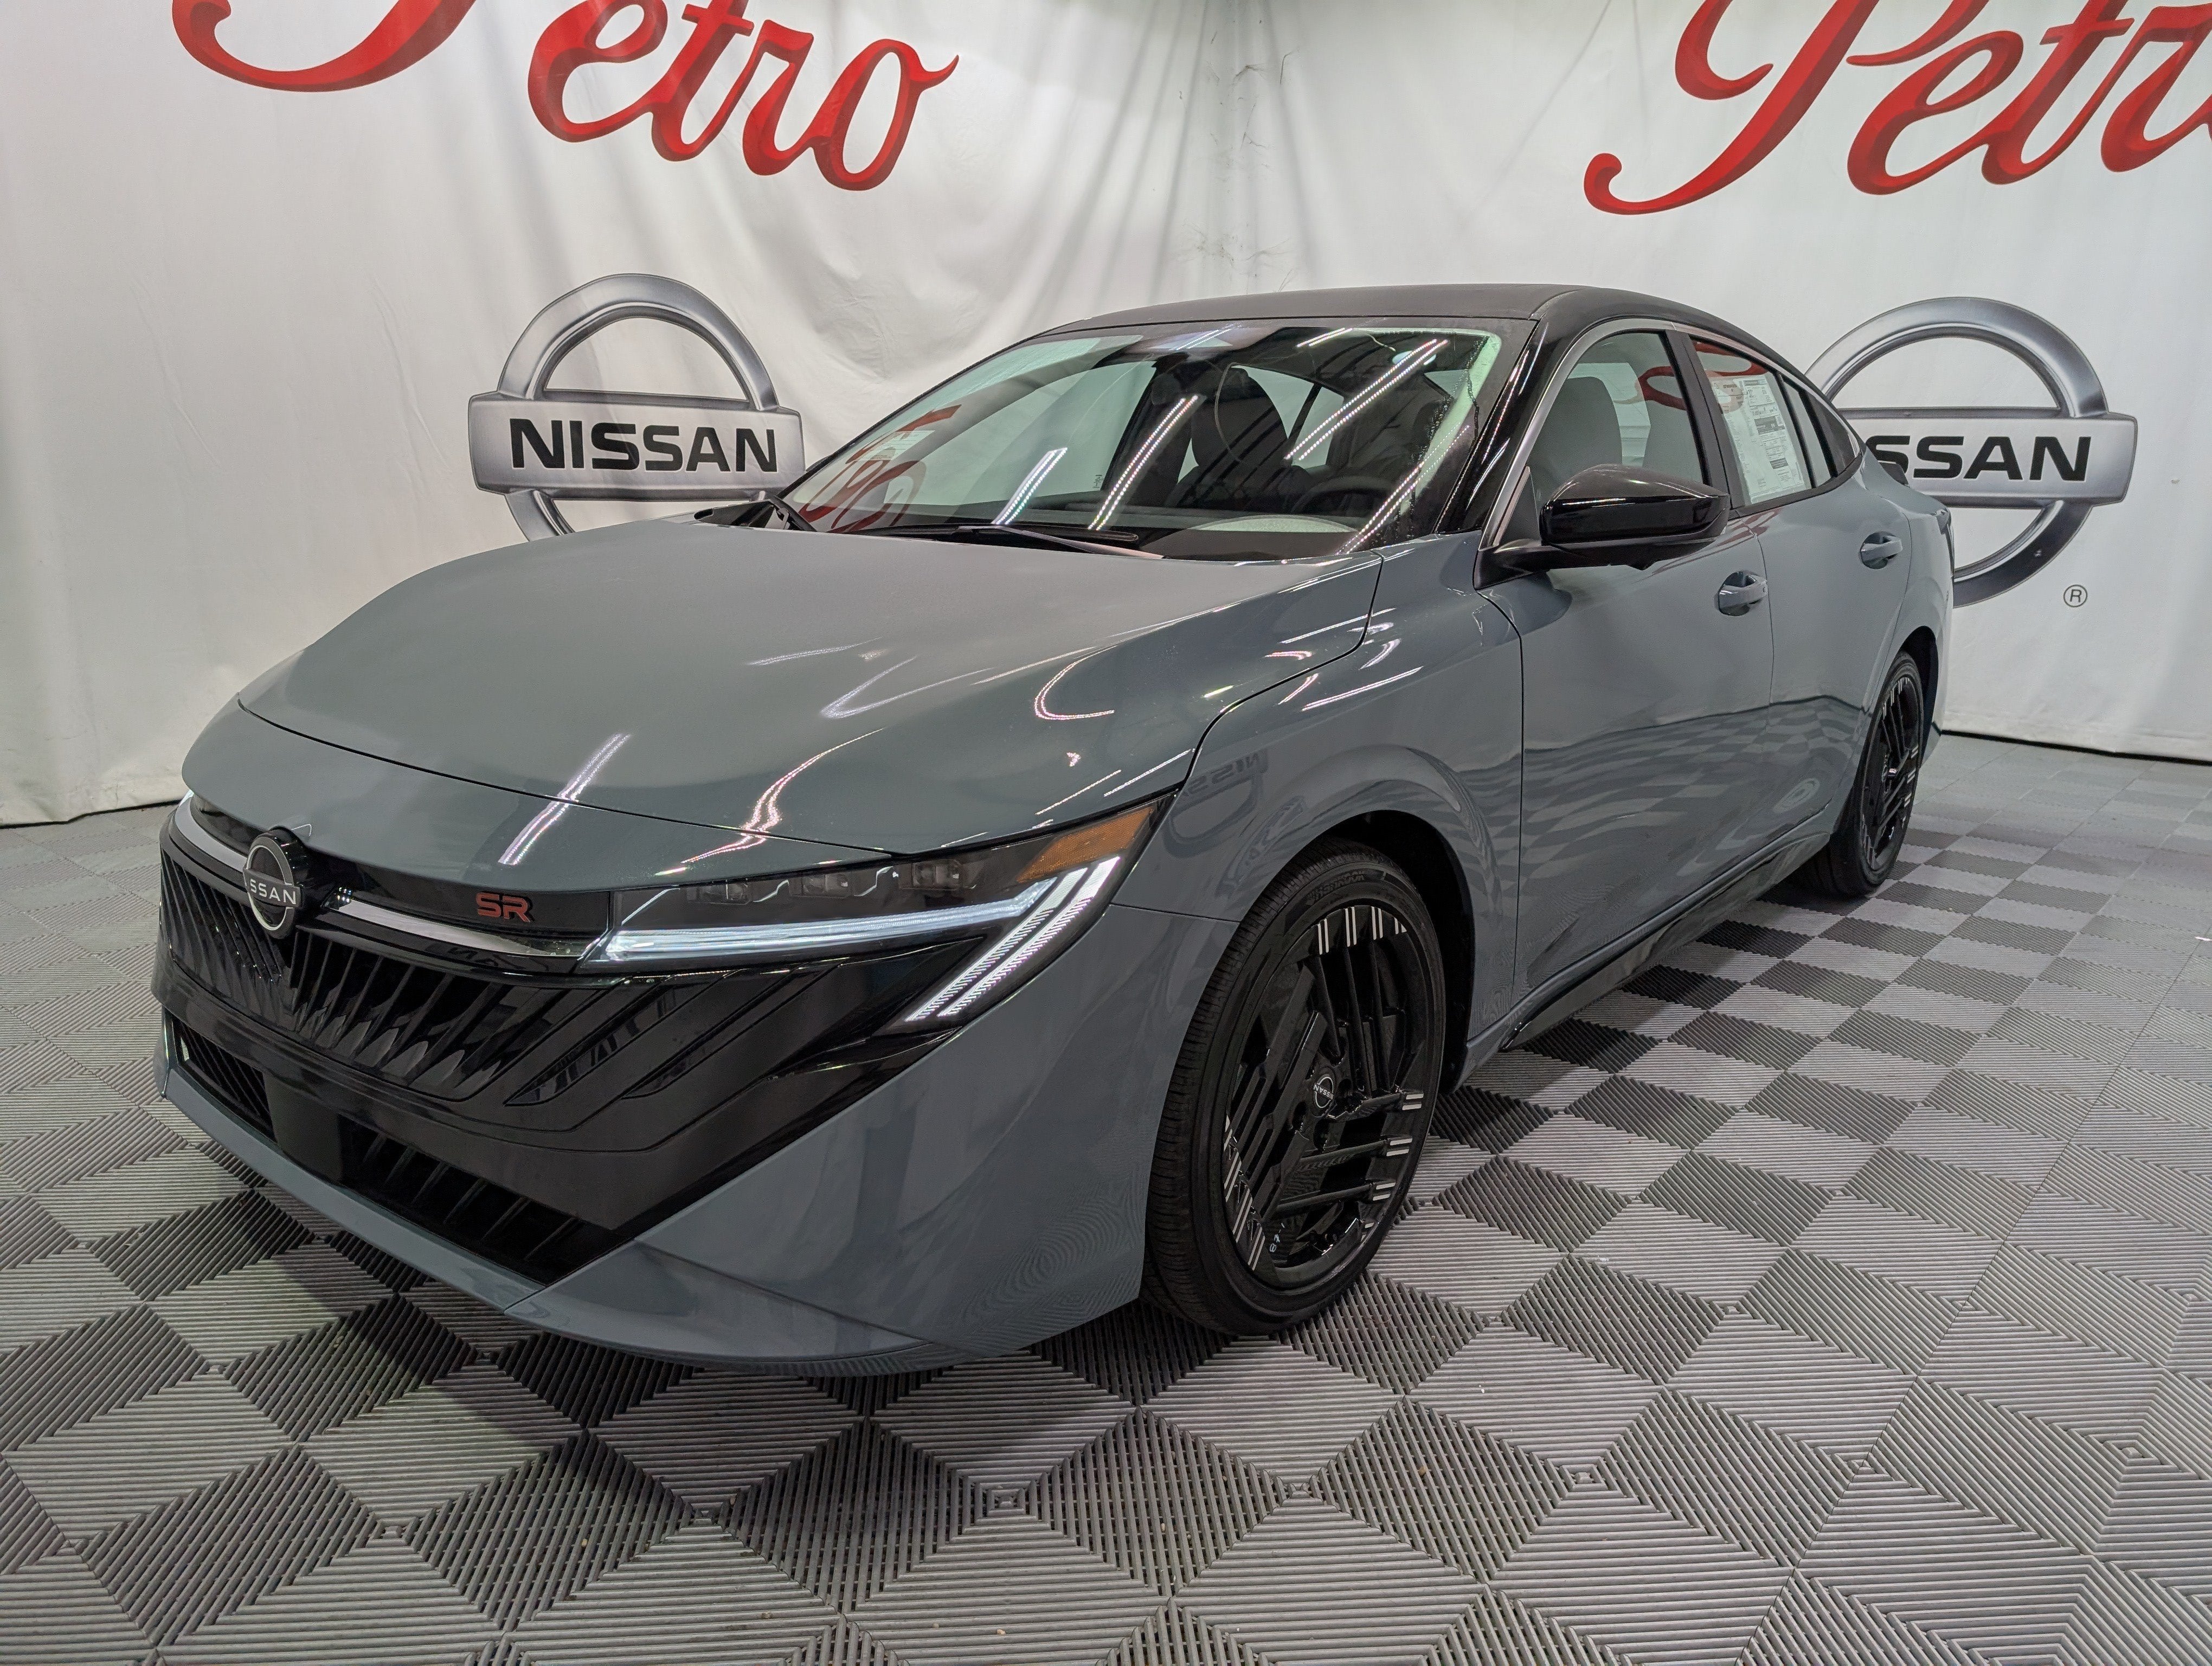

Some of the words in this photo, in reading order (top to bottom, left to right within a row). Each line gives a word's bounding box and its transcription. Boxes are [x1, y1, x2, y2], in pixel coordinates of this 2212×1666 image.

[510, 418, 777, 472] NISSAN
[1866, 435, 2091, 482] SSAN
[250, 878, 297, 905] SSAN
[477, 892, 531, 922] SR
